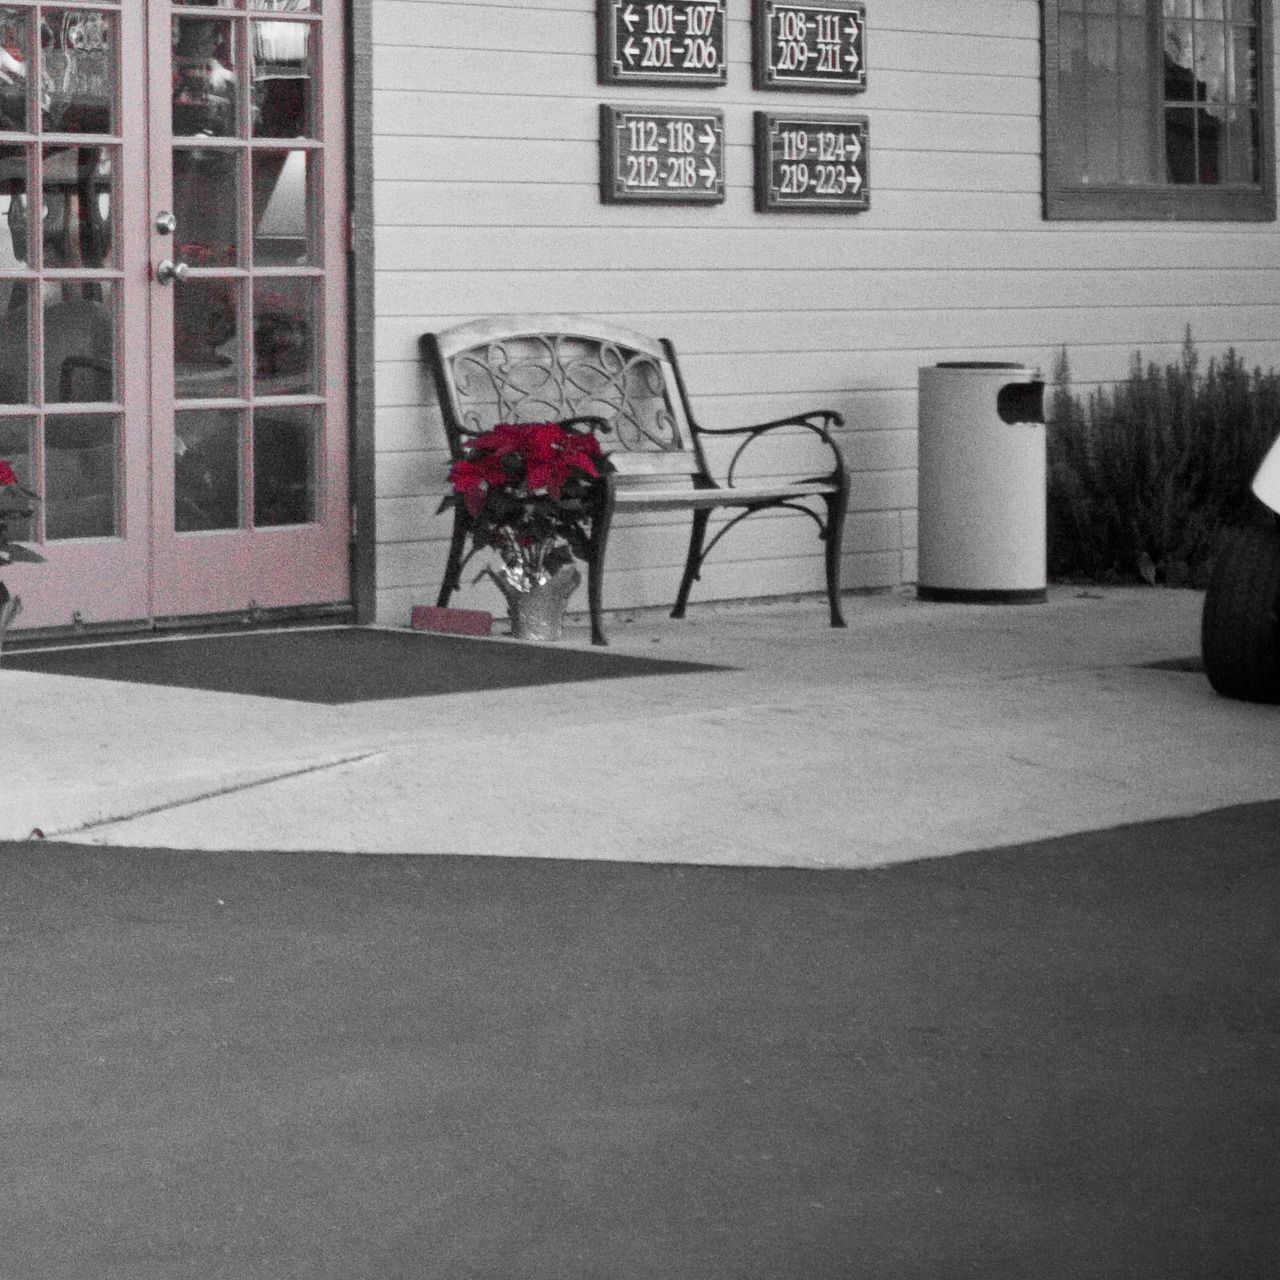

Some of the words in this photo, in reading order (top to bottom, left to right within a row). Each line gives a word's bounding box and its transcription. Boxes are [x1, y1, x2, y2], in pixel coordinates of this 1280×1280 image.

[644, 4, 716, 36] 101-107
[777, 11, 842, 43] 108-111
[641, 37, 717, 68] 201-206
[777, 41, 843, 72] 209-211
[628, 120, 695, 153] 112-118
[781, 131, 846, 161] 119-124
[626, 156, 697, 187] 212-218
[780, 164, 847, 194] 219-223
